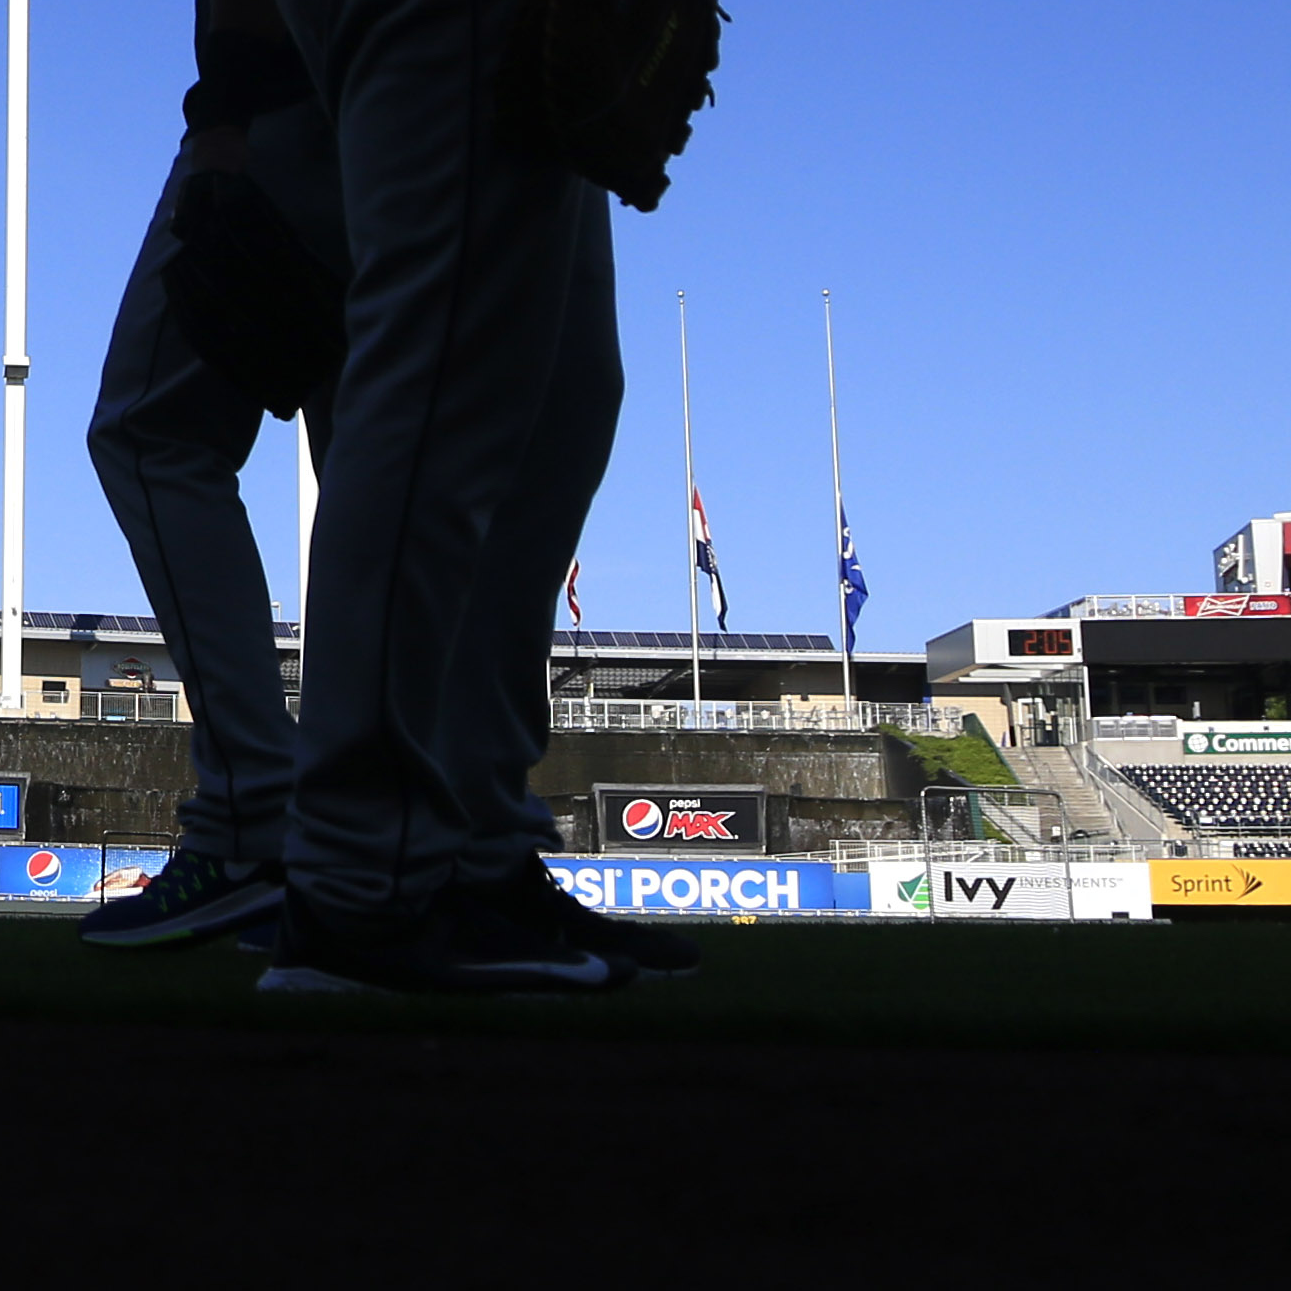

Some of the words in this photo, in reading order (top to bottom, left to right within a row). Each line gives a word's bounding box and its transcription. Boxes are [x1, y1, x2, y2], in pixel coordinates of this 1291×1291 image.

[1024, 629, 1073, 655] 2:05
[669, 798, 701, 810] pepsi
[664, 811, 736, 840] MAX
[631, 868, 800, 909] PORCH
[944, 870, 1017, 910] Ivy
[1019, 876, 1116, 889] INVESTMENTS
[1171, 873, 1233, 894] Sprint
